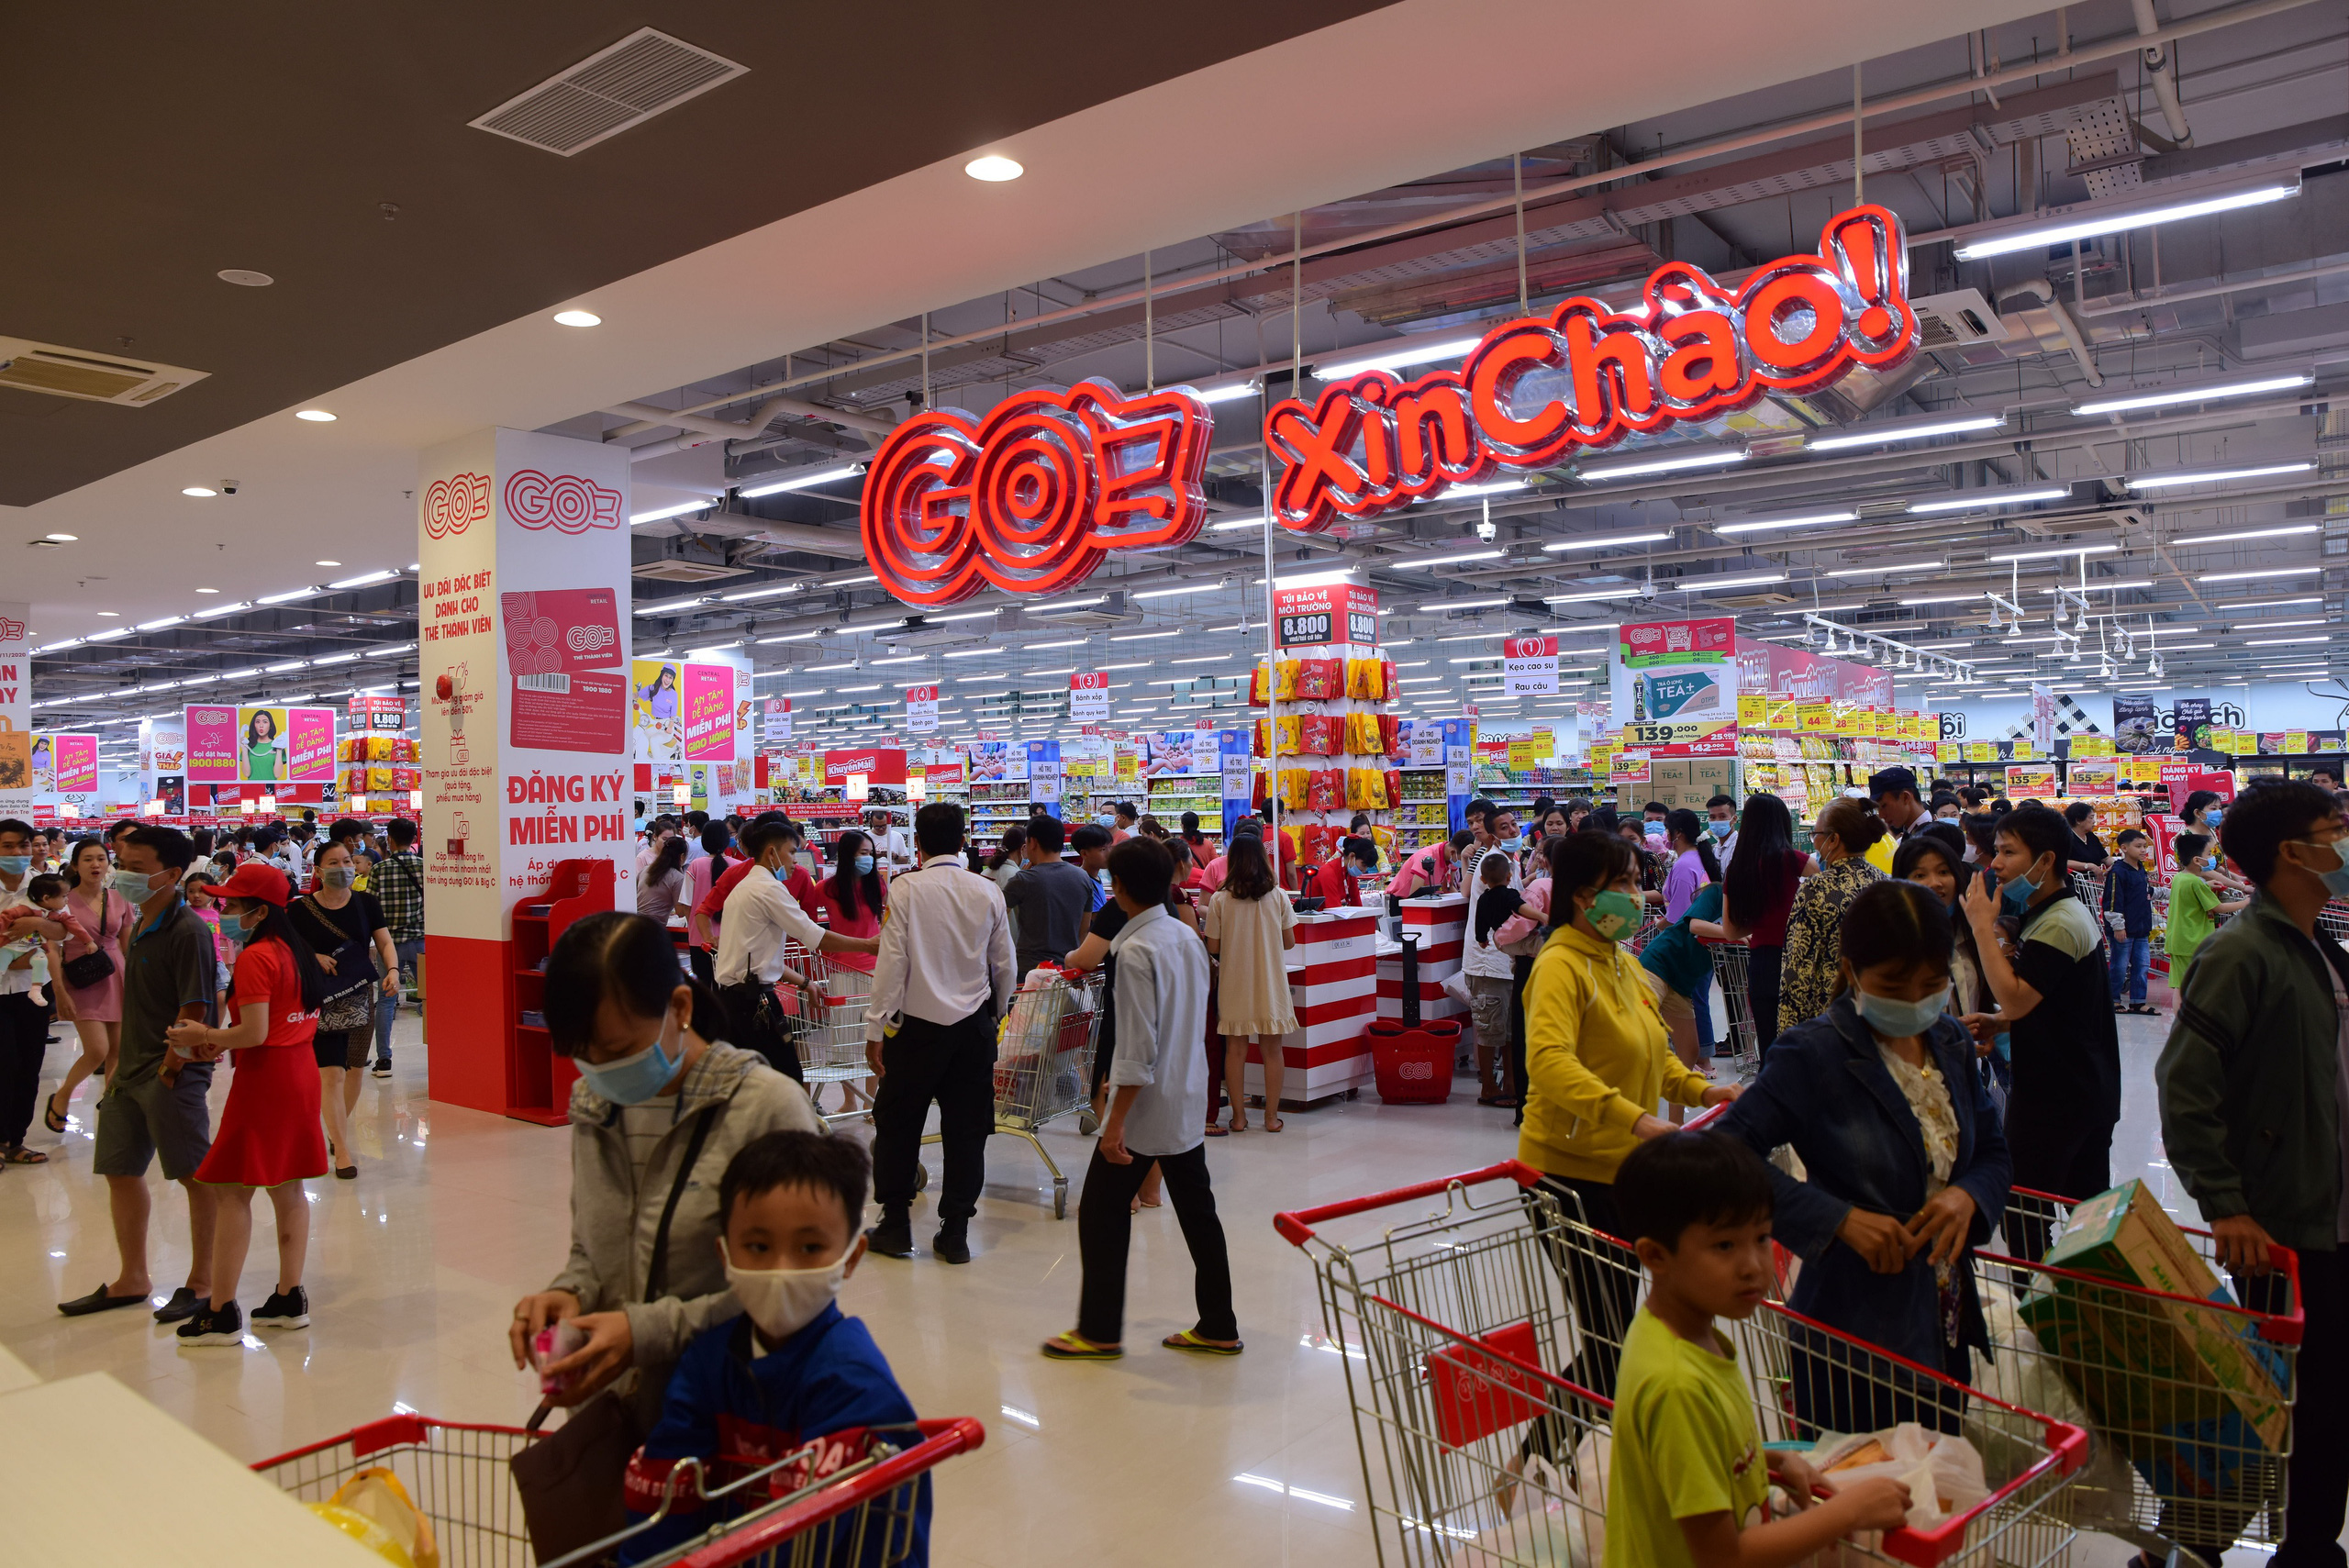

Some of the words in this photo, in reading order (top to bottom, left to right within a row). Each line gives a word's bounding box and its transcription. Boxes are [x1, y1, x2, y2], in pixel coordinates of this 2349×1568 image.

[438, 576, 451, 596] ĐÃI
[454, 573, 471, 595] ĐẶC
[474, 569, 492, 592] BIỆT
[1282, 594, 1295, 604] TÚI
[1297, 591, 1315, 602] BẢO
[1317, 589, 1328, 601] VỆ
[436, 599, 458, 618] DÀNH
[462, 596, 479, 614] CHO
[1278, 604, 1295, 615] MÔI
[1297, 602, 1332, 612] TRƯỜNG
[425, 621, 439, 642] THẺ
[441, 619, 469, 639] THÀNH
[472, 615, 492, 635] VIÊN
[1284, 615, 1327, 636] 8.800
[1350, 614, 1375, 635] 8.800
[1528, 642, 1533, 652] 1
[1508, 662, 1525, 673] Kẹo
[1527, 662, 1542, 671] cao
[1543, 662, 1553, 670] su
[1086, 676, 1092, 685] 3
[1515, 683, 1530, 691] Rau
[693, 695, 706, 707] AN
[707, 689, 724, 702] TÂM
[704, 701, 725, 715] DÀNG
[373, 713, 400, 724] 8.800
[686, 717, 712, 740] MIỄN
[716, 710, 731, 728] PHÍ
[1773, 715, 1784, 723] 29
[1808, 717, 1820, 726] 44
[296, 731, 308, 741] AN
[310, 727, 325, 736] TÂM
[687, 739, 707, 753] GIAO
[709, 728, 731, 745] HÀNG
[291, 749, 315, 765] MIỄN
[317, 742, 332, 757] PHÍ
[82, 762, 95, 774] PHÍ
[189, 759, 212, 767] 1900
[213, 759, 236, 767] 1880
[292, 763, 309, 775] GIAO
[311, 756, 331, 771] HÀNG
[2188, 765, 2200, 773] KÝ
[507, 770, 584, 804] ĐĂNG
[591, 769, 625, 802] KÝ
[509, 805, 578, 846] MIỄN
[584, 808, 625, 842] PHÍ
[528, 857, 543, 872] Áp
[509, 875, 524, 889] hệ
[528, 873, 552, 886] thốn
[620, 870, 629, 879] C
